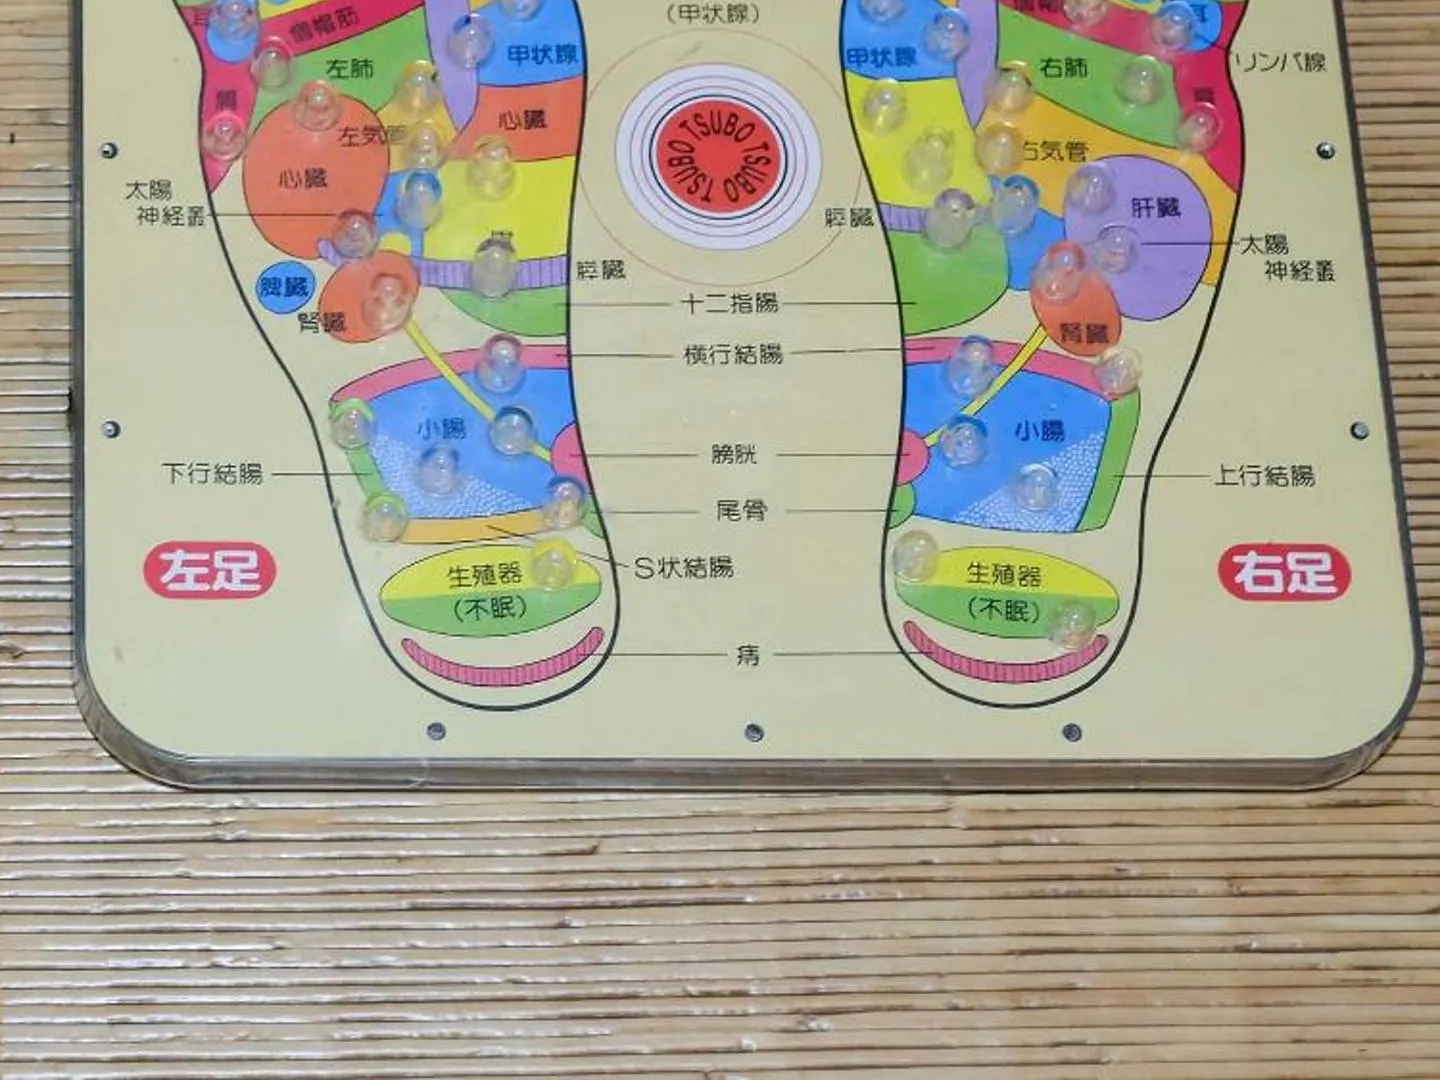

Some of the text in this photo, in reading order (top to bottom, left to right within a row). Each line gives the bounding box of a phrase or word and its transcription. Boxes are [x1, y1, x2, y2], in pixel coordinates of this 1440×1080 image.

[326, 58, 374, 79] 左肺
[1040, 57, 1089, 78] 右肺
[499, 110, 547, 131] 心臓
[679, 110, 756, 142] TSUBO
[279, 167, 327, 190] 心臓
[667, 140, 713, 203] TSUBO
[723, 141, 772, 203] TSUBO
[126, 180, 173, 201] 太陽
[1132, 197, 1181, 219] 肝臓
[1240, 234, 1289, 256] 太陽
[680, 292, 779, 315] 十二指腸
[683, 343, 784, 366] 横行結腸
[418, 416, 468, 441] 小腸
[1014, 419, 1066, 443] 小腸
[711, 444, 758, 465] 膀胱
[161, 461, 265, 486] 下行結腸
[1214, 463, 1317, 487] 上行結腸
[716, 499, 769, 522] 尾骨
[159, 549, 262, 592] 左足
[447, 562, 524, 589] 生殖器
[633, 556, 735, 580] S状結腸
[967, 563, 1043, 588] 生殖器
[1233, 551, 1338, 595] 右足
